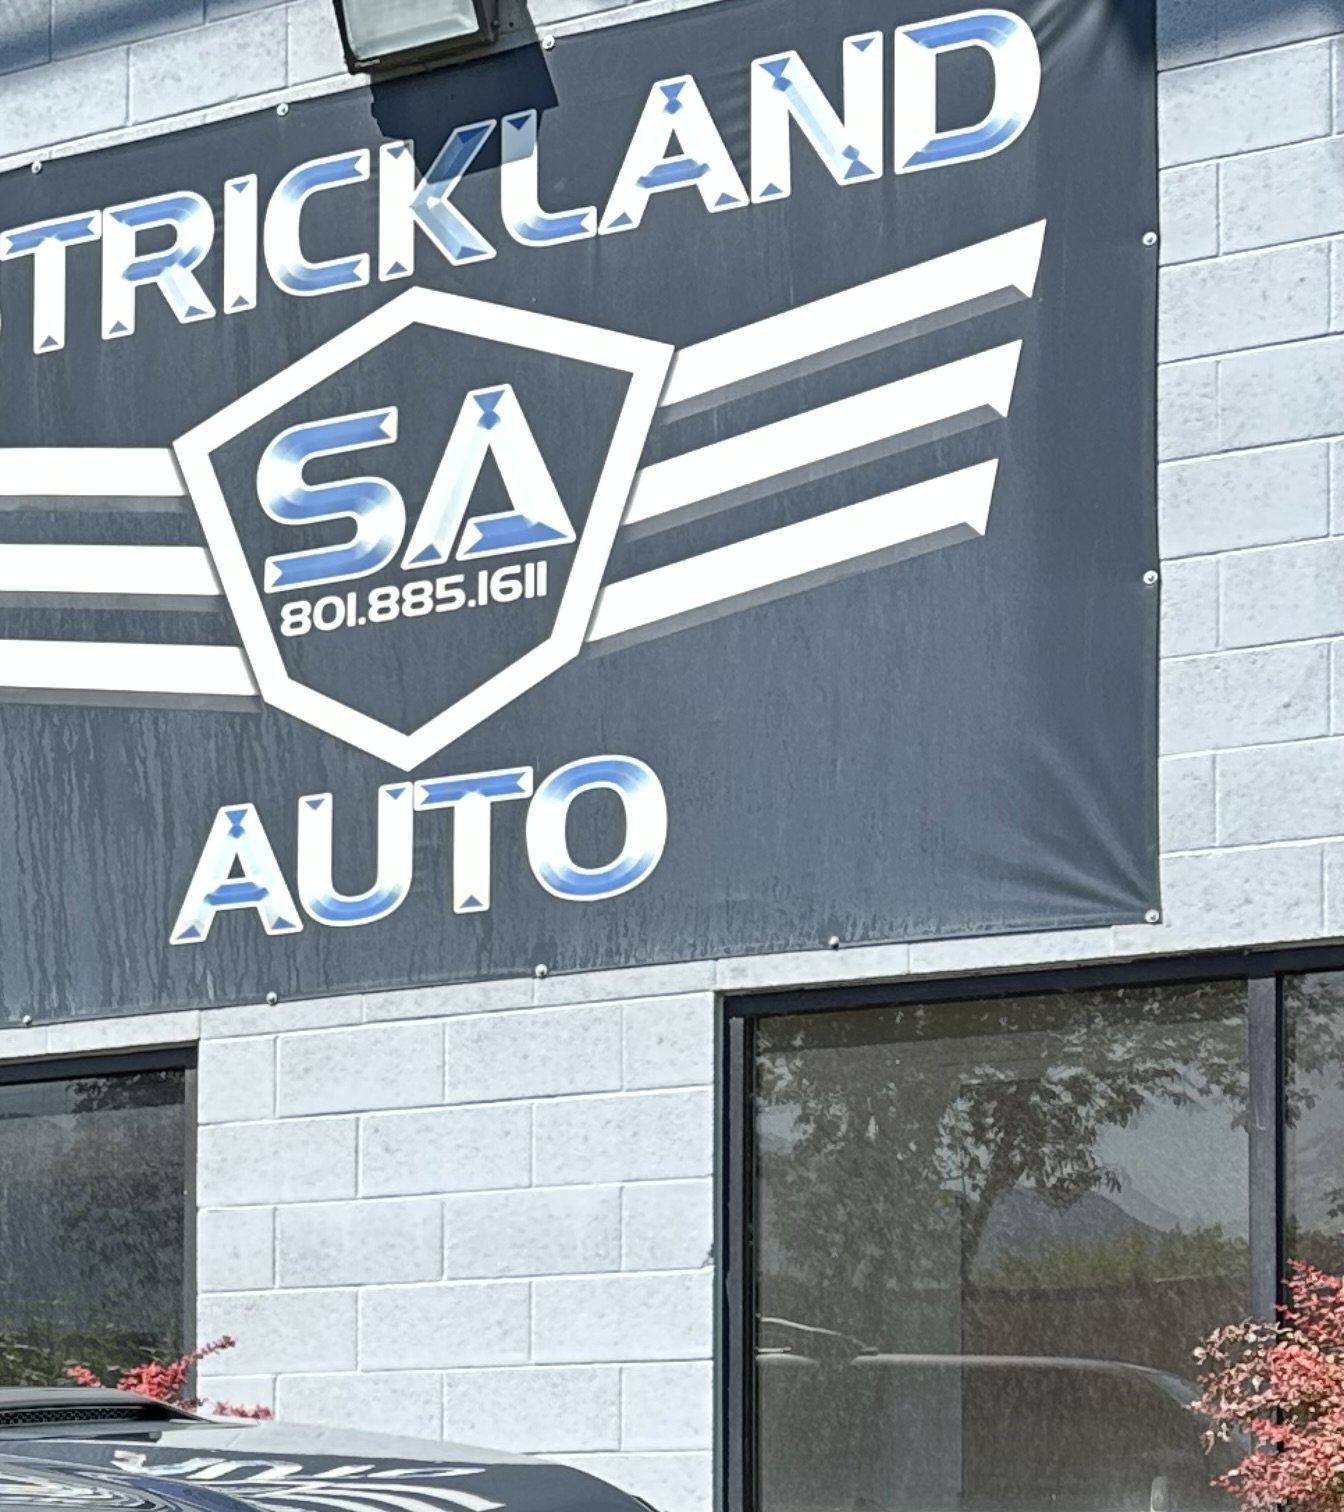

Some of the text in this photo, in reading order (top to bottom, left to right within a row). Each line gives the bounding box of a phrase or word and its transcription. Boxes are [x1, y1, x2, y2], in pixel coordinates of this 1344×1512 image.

[254, 383, 577, 595] SA
[280, 560, 548, 637] 801.885.1611
[169, 754, 668, 944] AUTO
